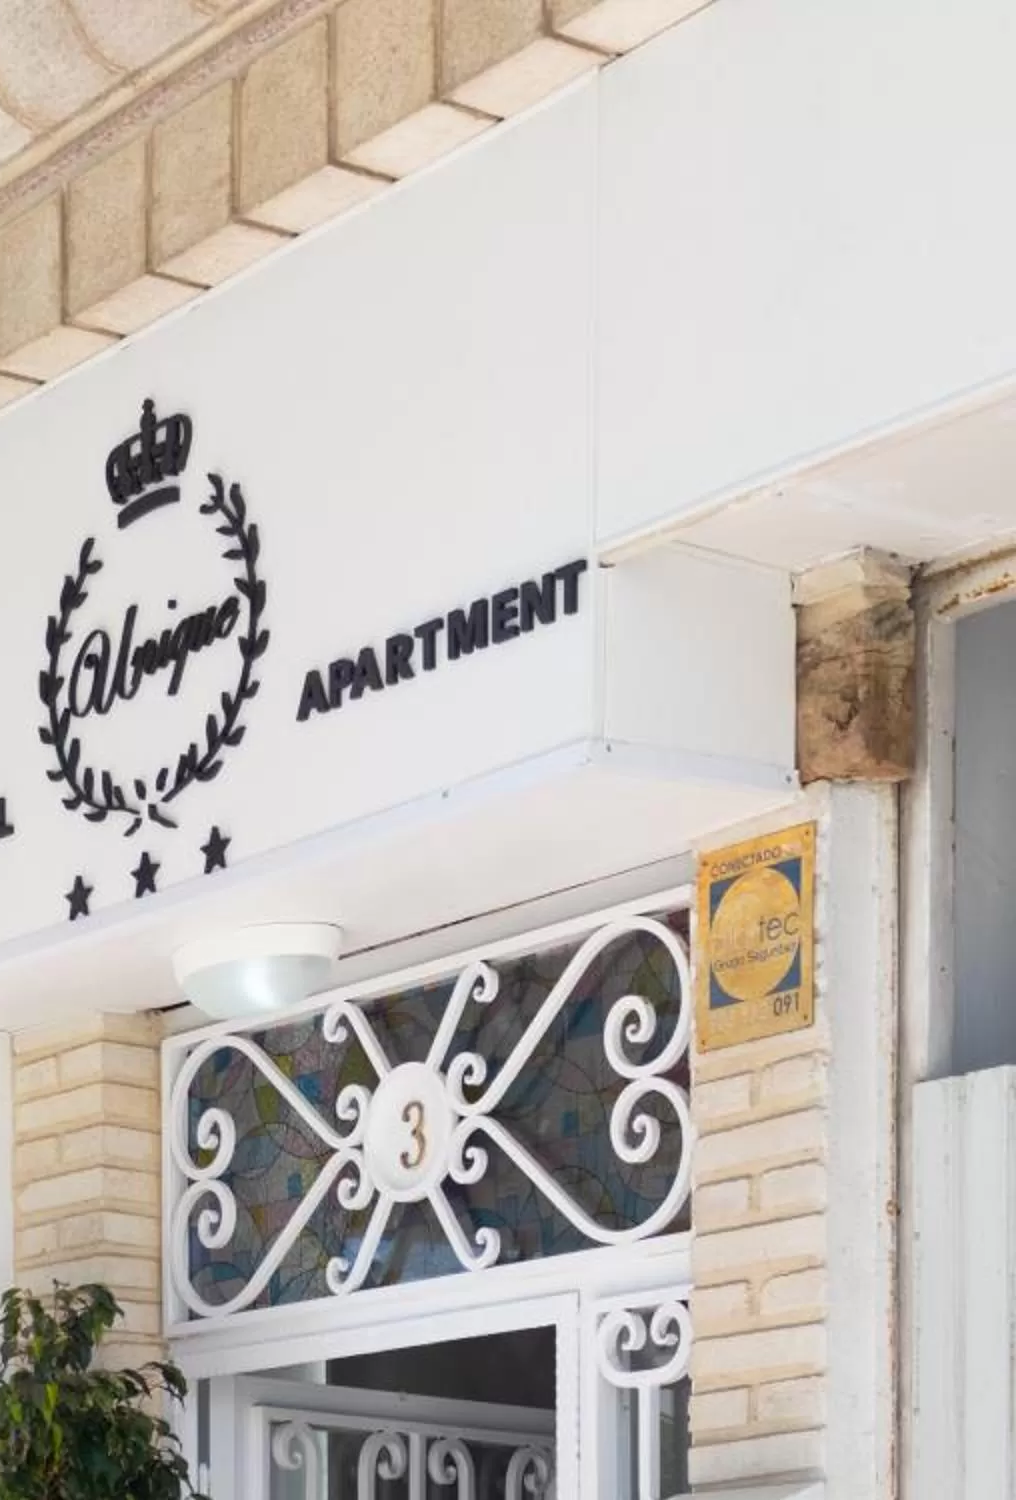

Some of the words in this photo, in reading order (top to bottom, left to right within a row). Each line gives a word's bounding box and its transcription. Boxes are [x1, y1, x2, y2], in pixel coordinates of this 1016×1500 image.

[67, 596, 241, 718] Unique
[296, 559, 588, 722] APARTMENT
[773, 991, 800, 1016] 091
[399, 1100, 427, 1169] 3
